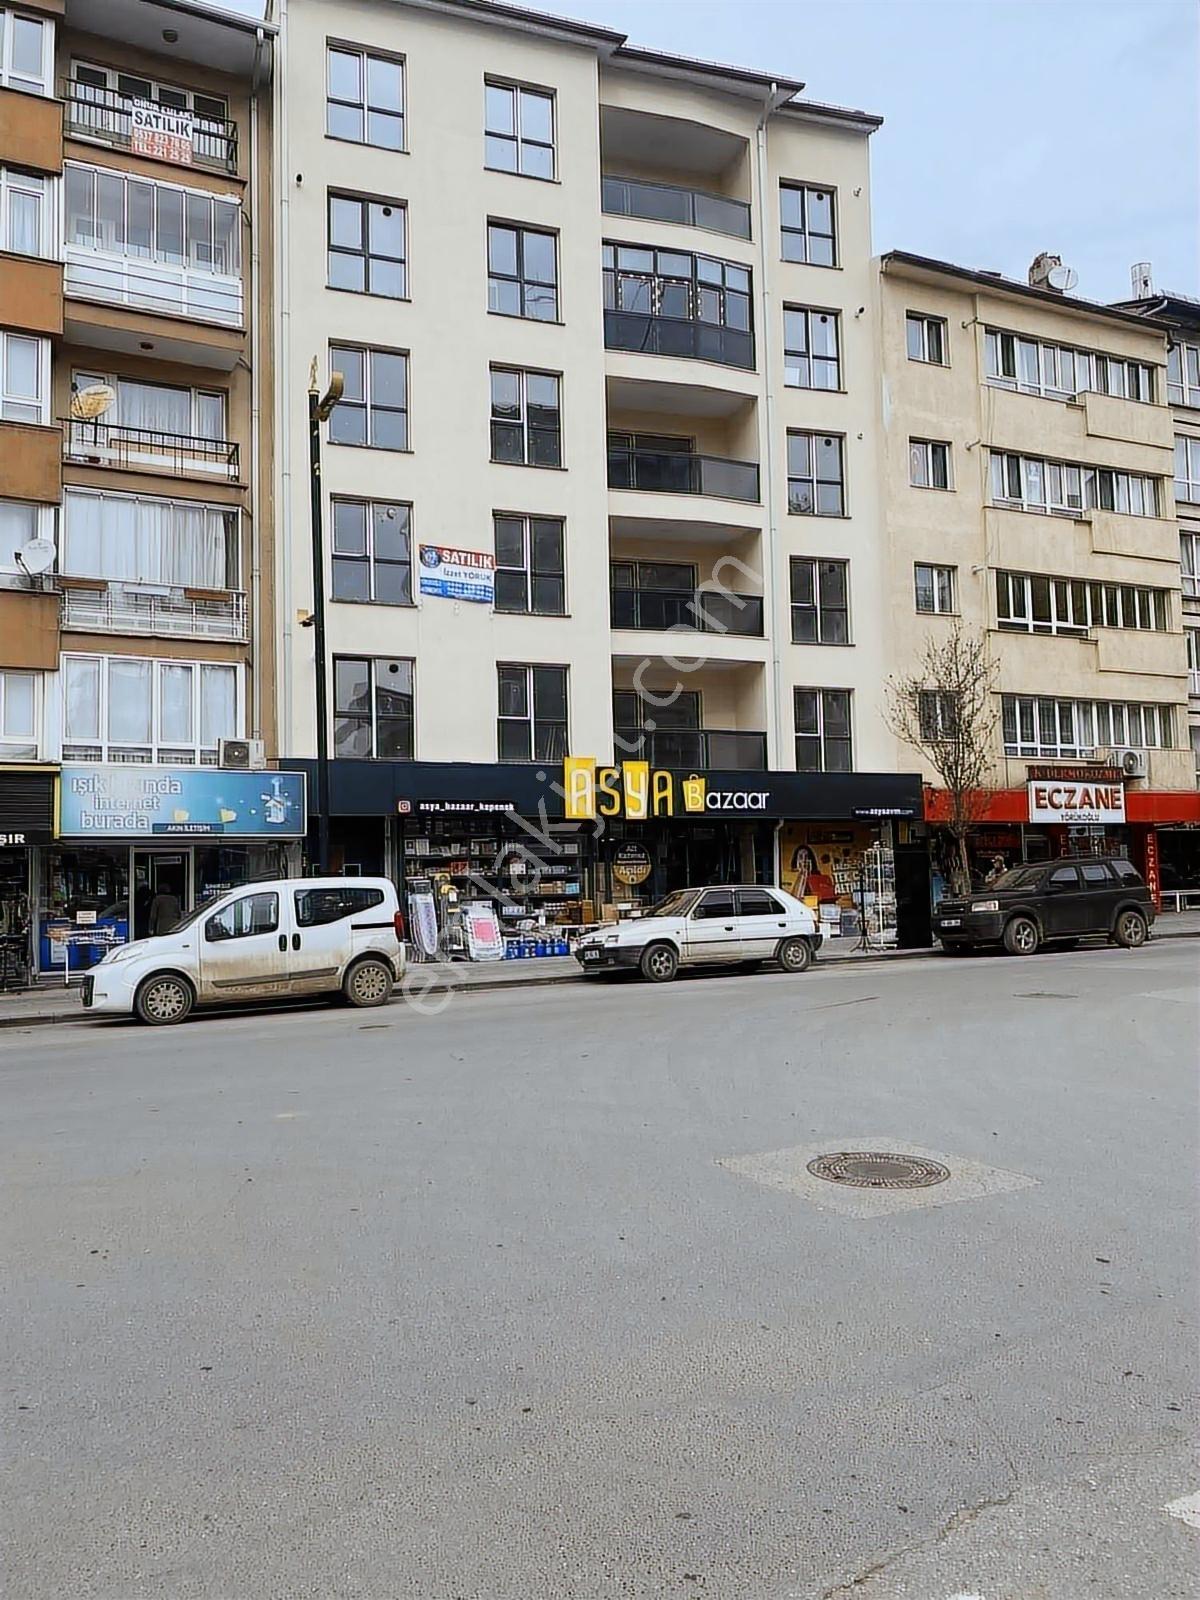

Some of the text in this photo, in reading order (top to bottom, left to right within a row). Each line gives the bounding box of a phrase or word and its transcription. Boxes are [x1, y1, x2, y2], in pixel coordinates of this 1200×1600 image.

[134, 111, 190, 138] SATILIK
[441, 549, 494, 570] SATILIK
[94, 796, 160, 811] internet
[570, 767, 674, 817] ASYA
[687, 782, 770, 810] Bazaar
[1034, 786, 1123, 810] ECZANE
[81, 811, 149, 830] burada
[1146, 833, 1158, 904] ECZANE
